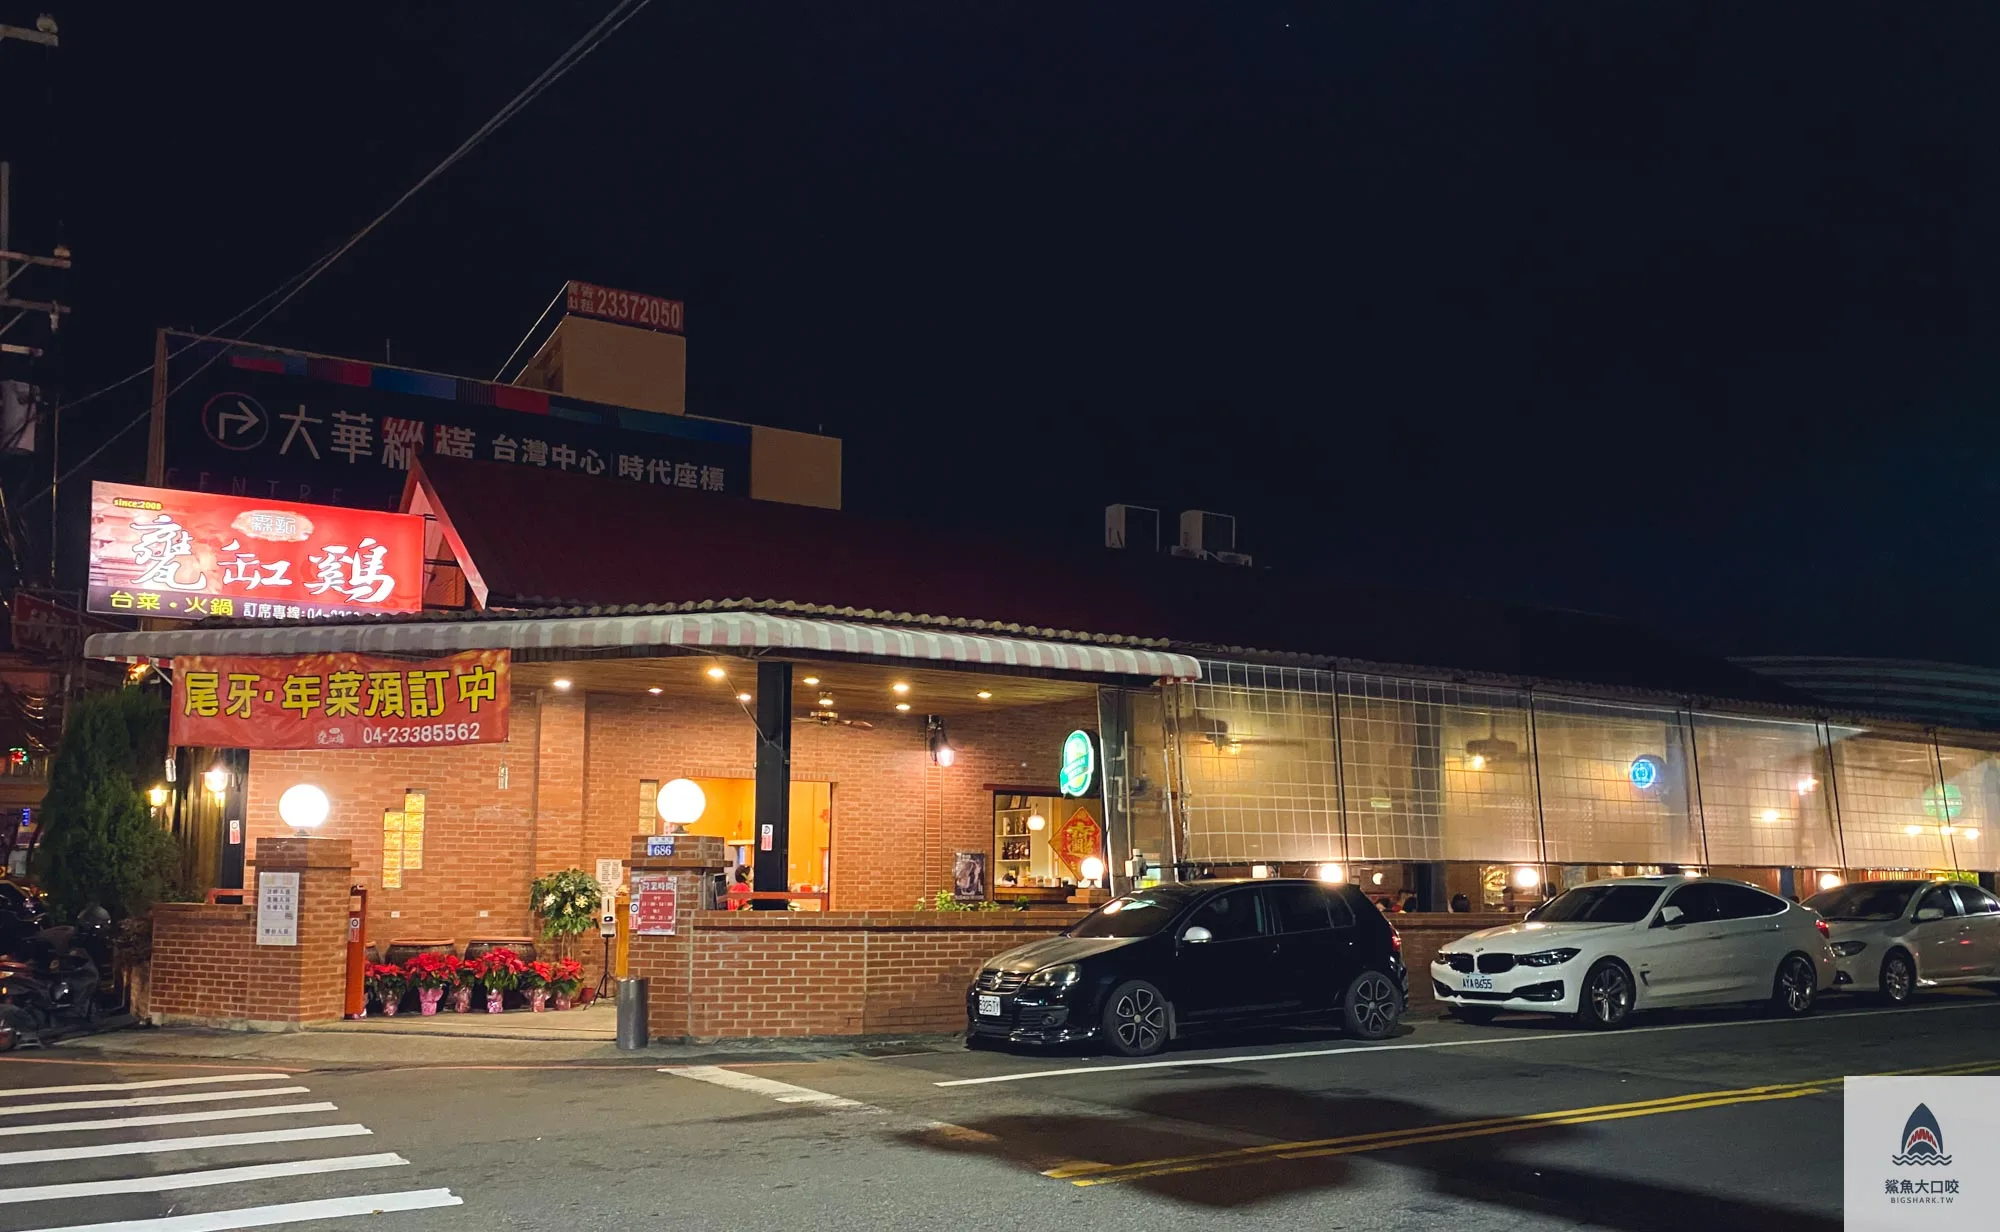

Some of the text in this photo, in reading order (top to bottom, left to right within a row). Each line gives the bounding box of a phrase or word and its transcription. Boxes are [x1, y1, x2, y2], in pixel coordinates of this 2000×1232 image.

[597, 290, 680, 329] 23372050
[491, 433, 606, 476] 台灣中心
[618, 453, 725, 492] 時代座標
[363, 722, 480, 744] 04-23385562
[654, 845, 672, 856] 686
